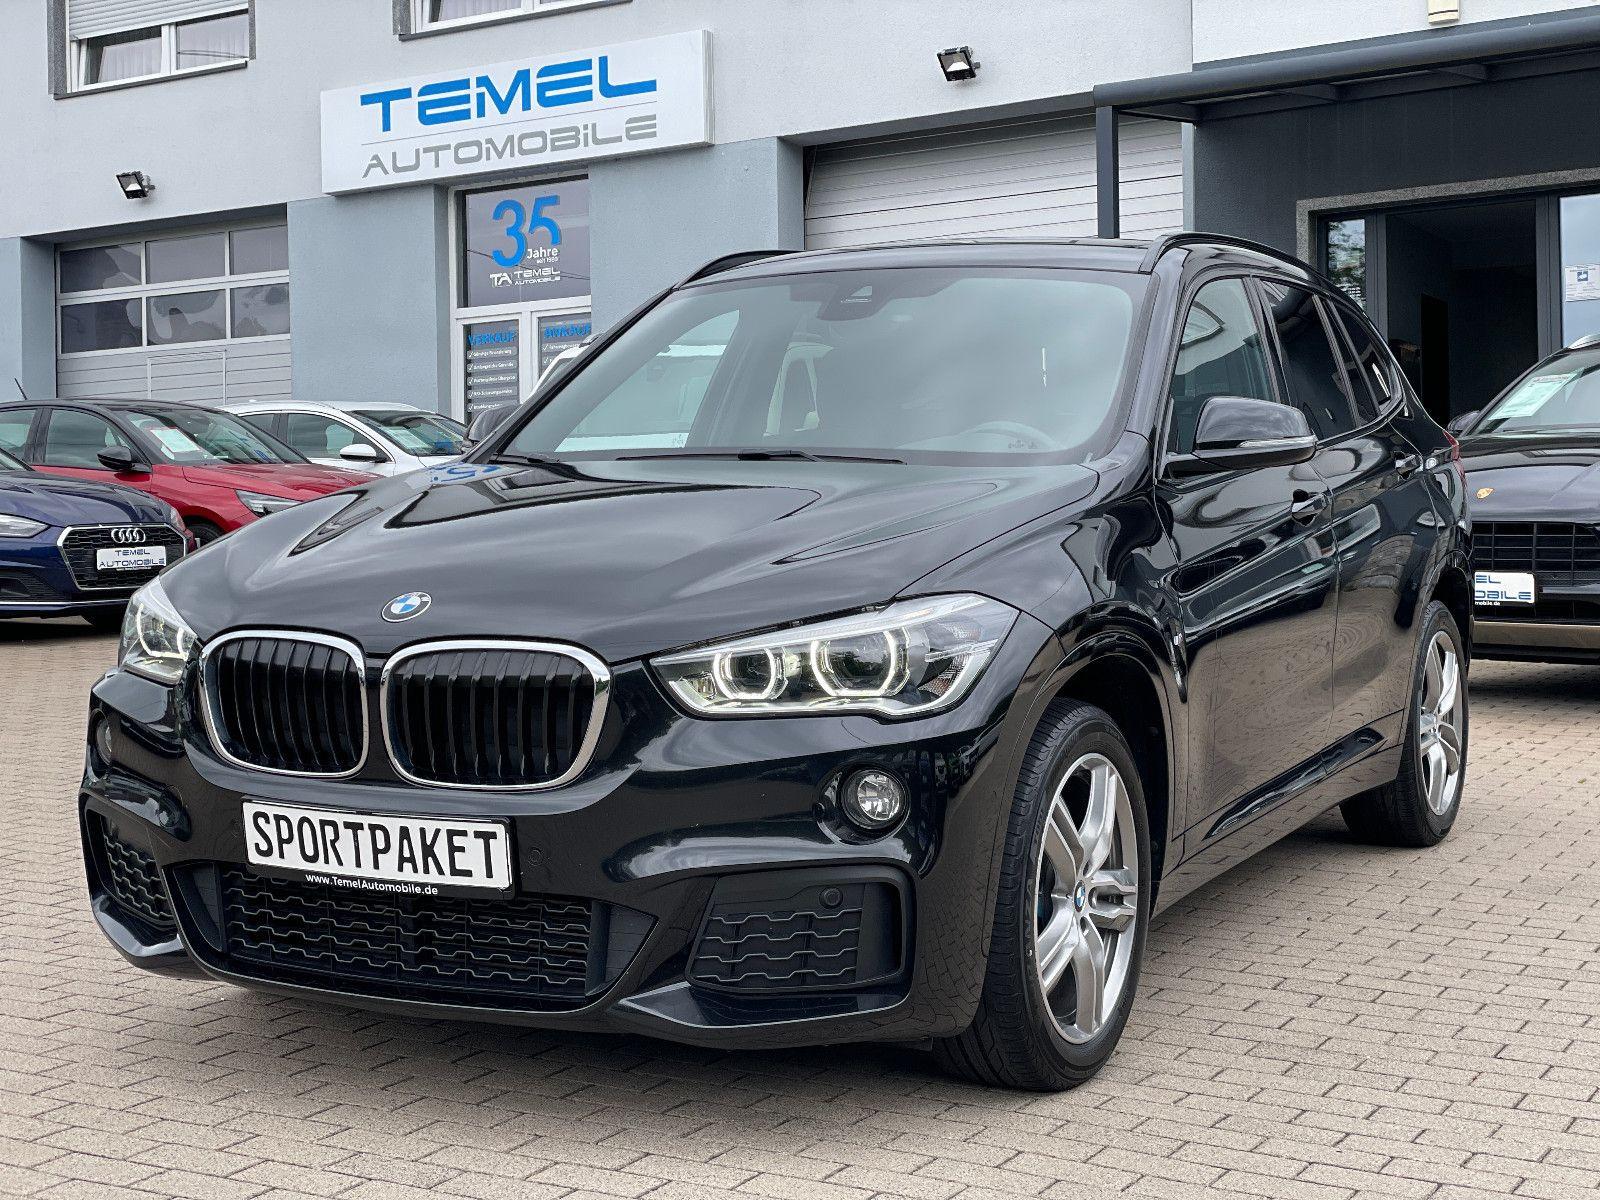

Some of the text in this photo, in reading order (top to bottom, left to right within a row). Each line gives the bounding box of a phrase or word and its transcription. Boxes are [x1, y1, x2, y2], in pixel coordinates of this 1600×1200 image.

[360, 55, 657, 132] TEMEL
[492, 195, 561, 267] 35
[526, 247, 559, 260] Jahre
[513, 267, 561, 279] TEMEL
[467, 331, 514, 345] VERKAUF
[1476, 575, 1501, 584] EL
[1475, 591, 1531, 600] OBILE
[252, 810, 498, 879] SPORTPAKET
[305, 872, 439, 896] www.TemelAutomobile.de
